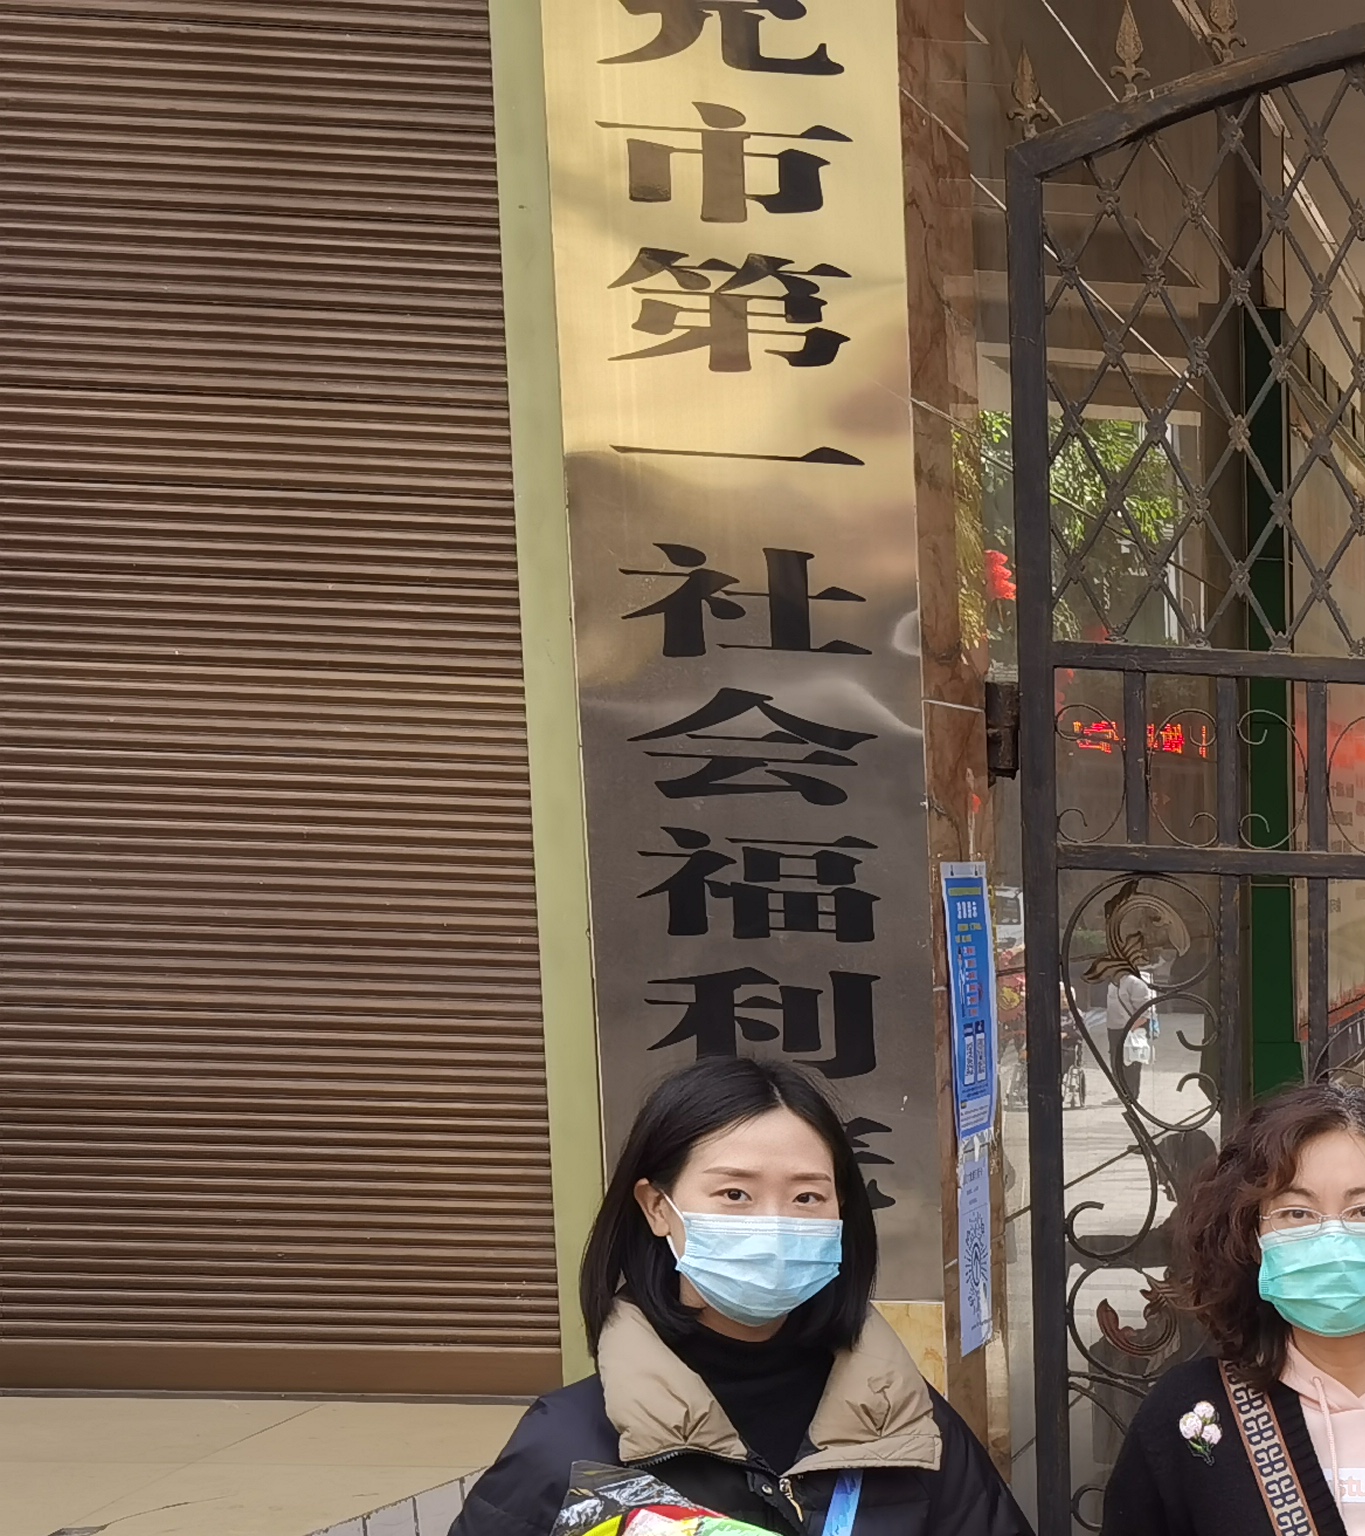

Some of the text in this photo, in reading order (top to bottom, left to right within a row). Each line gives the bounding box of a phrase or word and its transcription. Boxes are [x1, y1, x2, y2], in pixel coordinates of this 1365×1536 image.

[595, 0, 895, 1212] 充市第一社会福利
